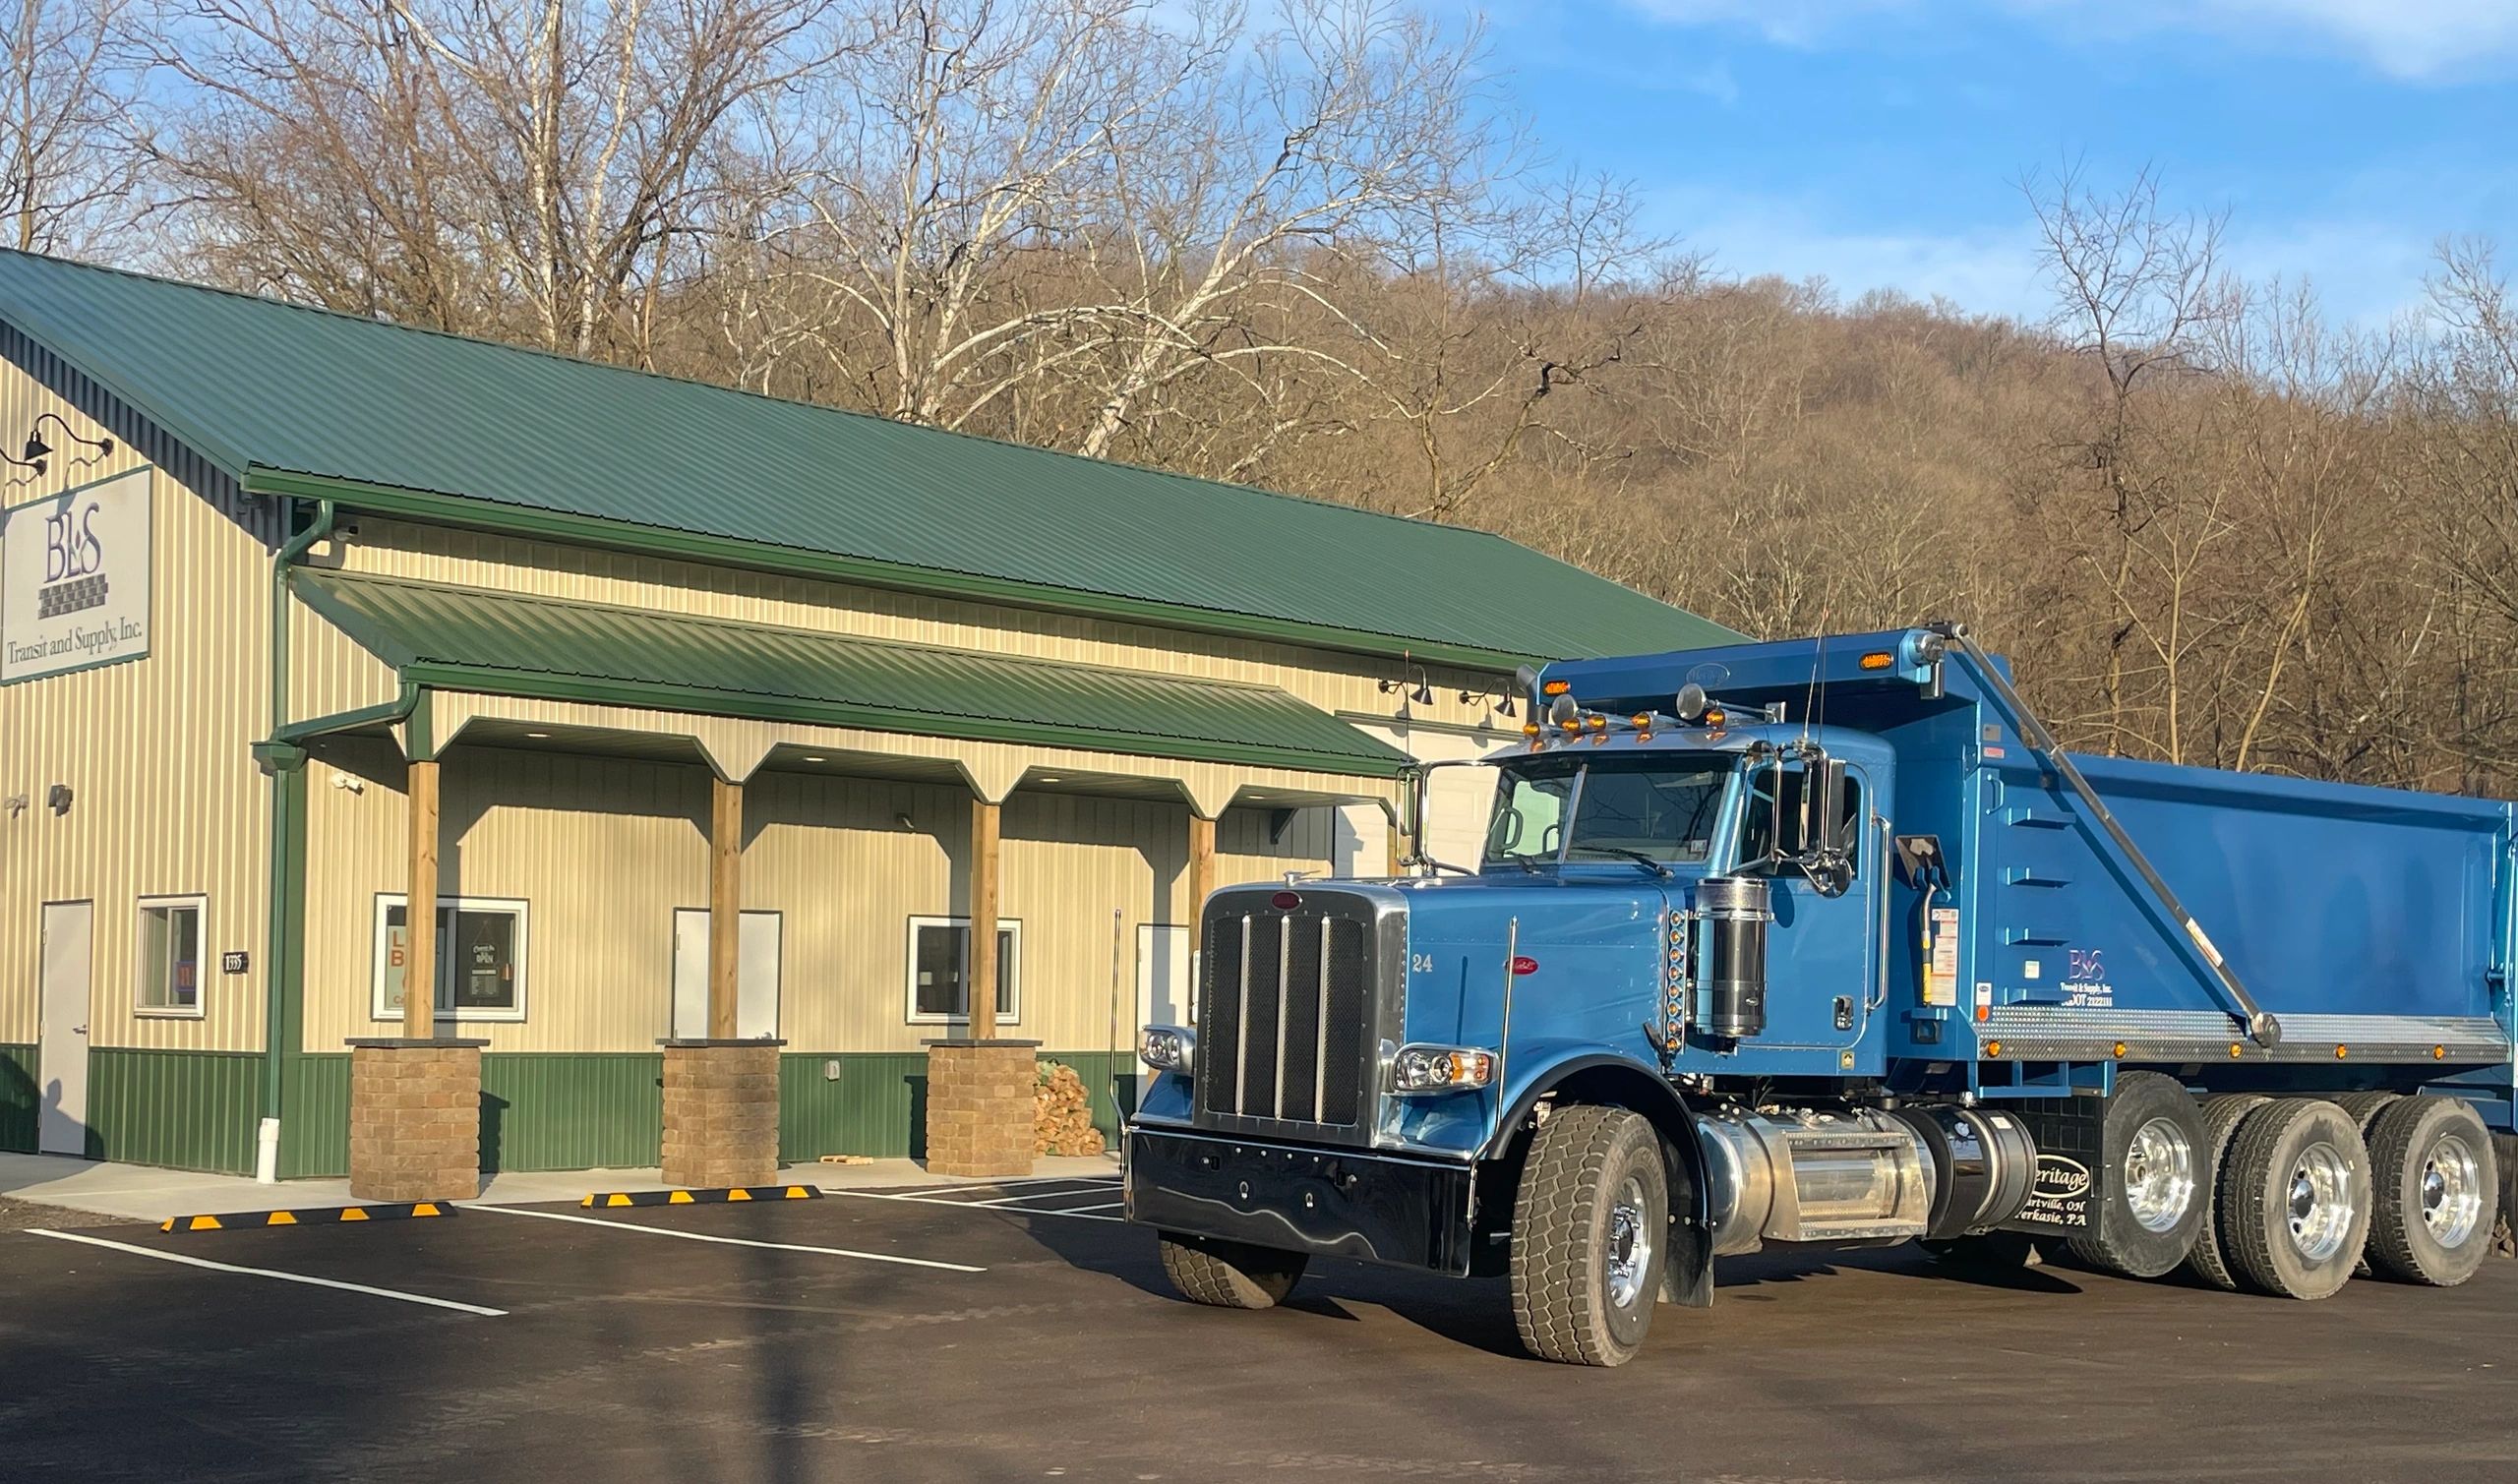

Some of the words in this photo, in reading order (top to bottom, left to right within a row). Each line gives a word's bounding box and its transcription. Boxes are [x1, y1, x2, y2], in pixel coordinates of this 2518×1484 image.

[8, 635, 47, 664] Transit
[50, 629, 73, 655] and
[75, 621, 117, 655] Supply,
[120, 617, 143, 640] Inc.
[1412, 953, 1432, 973] 24
[2035, 1166, 2087, 1191] eritage
[2014, 1209, 2064, 1225] erkasie,
[2067, 1214, 2086, 1225] PA
